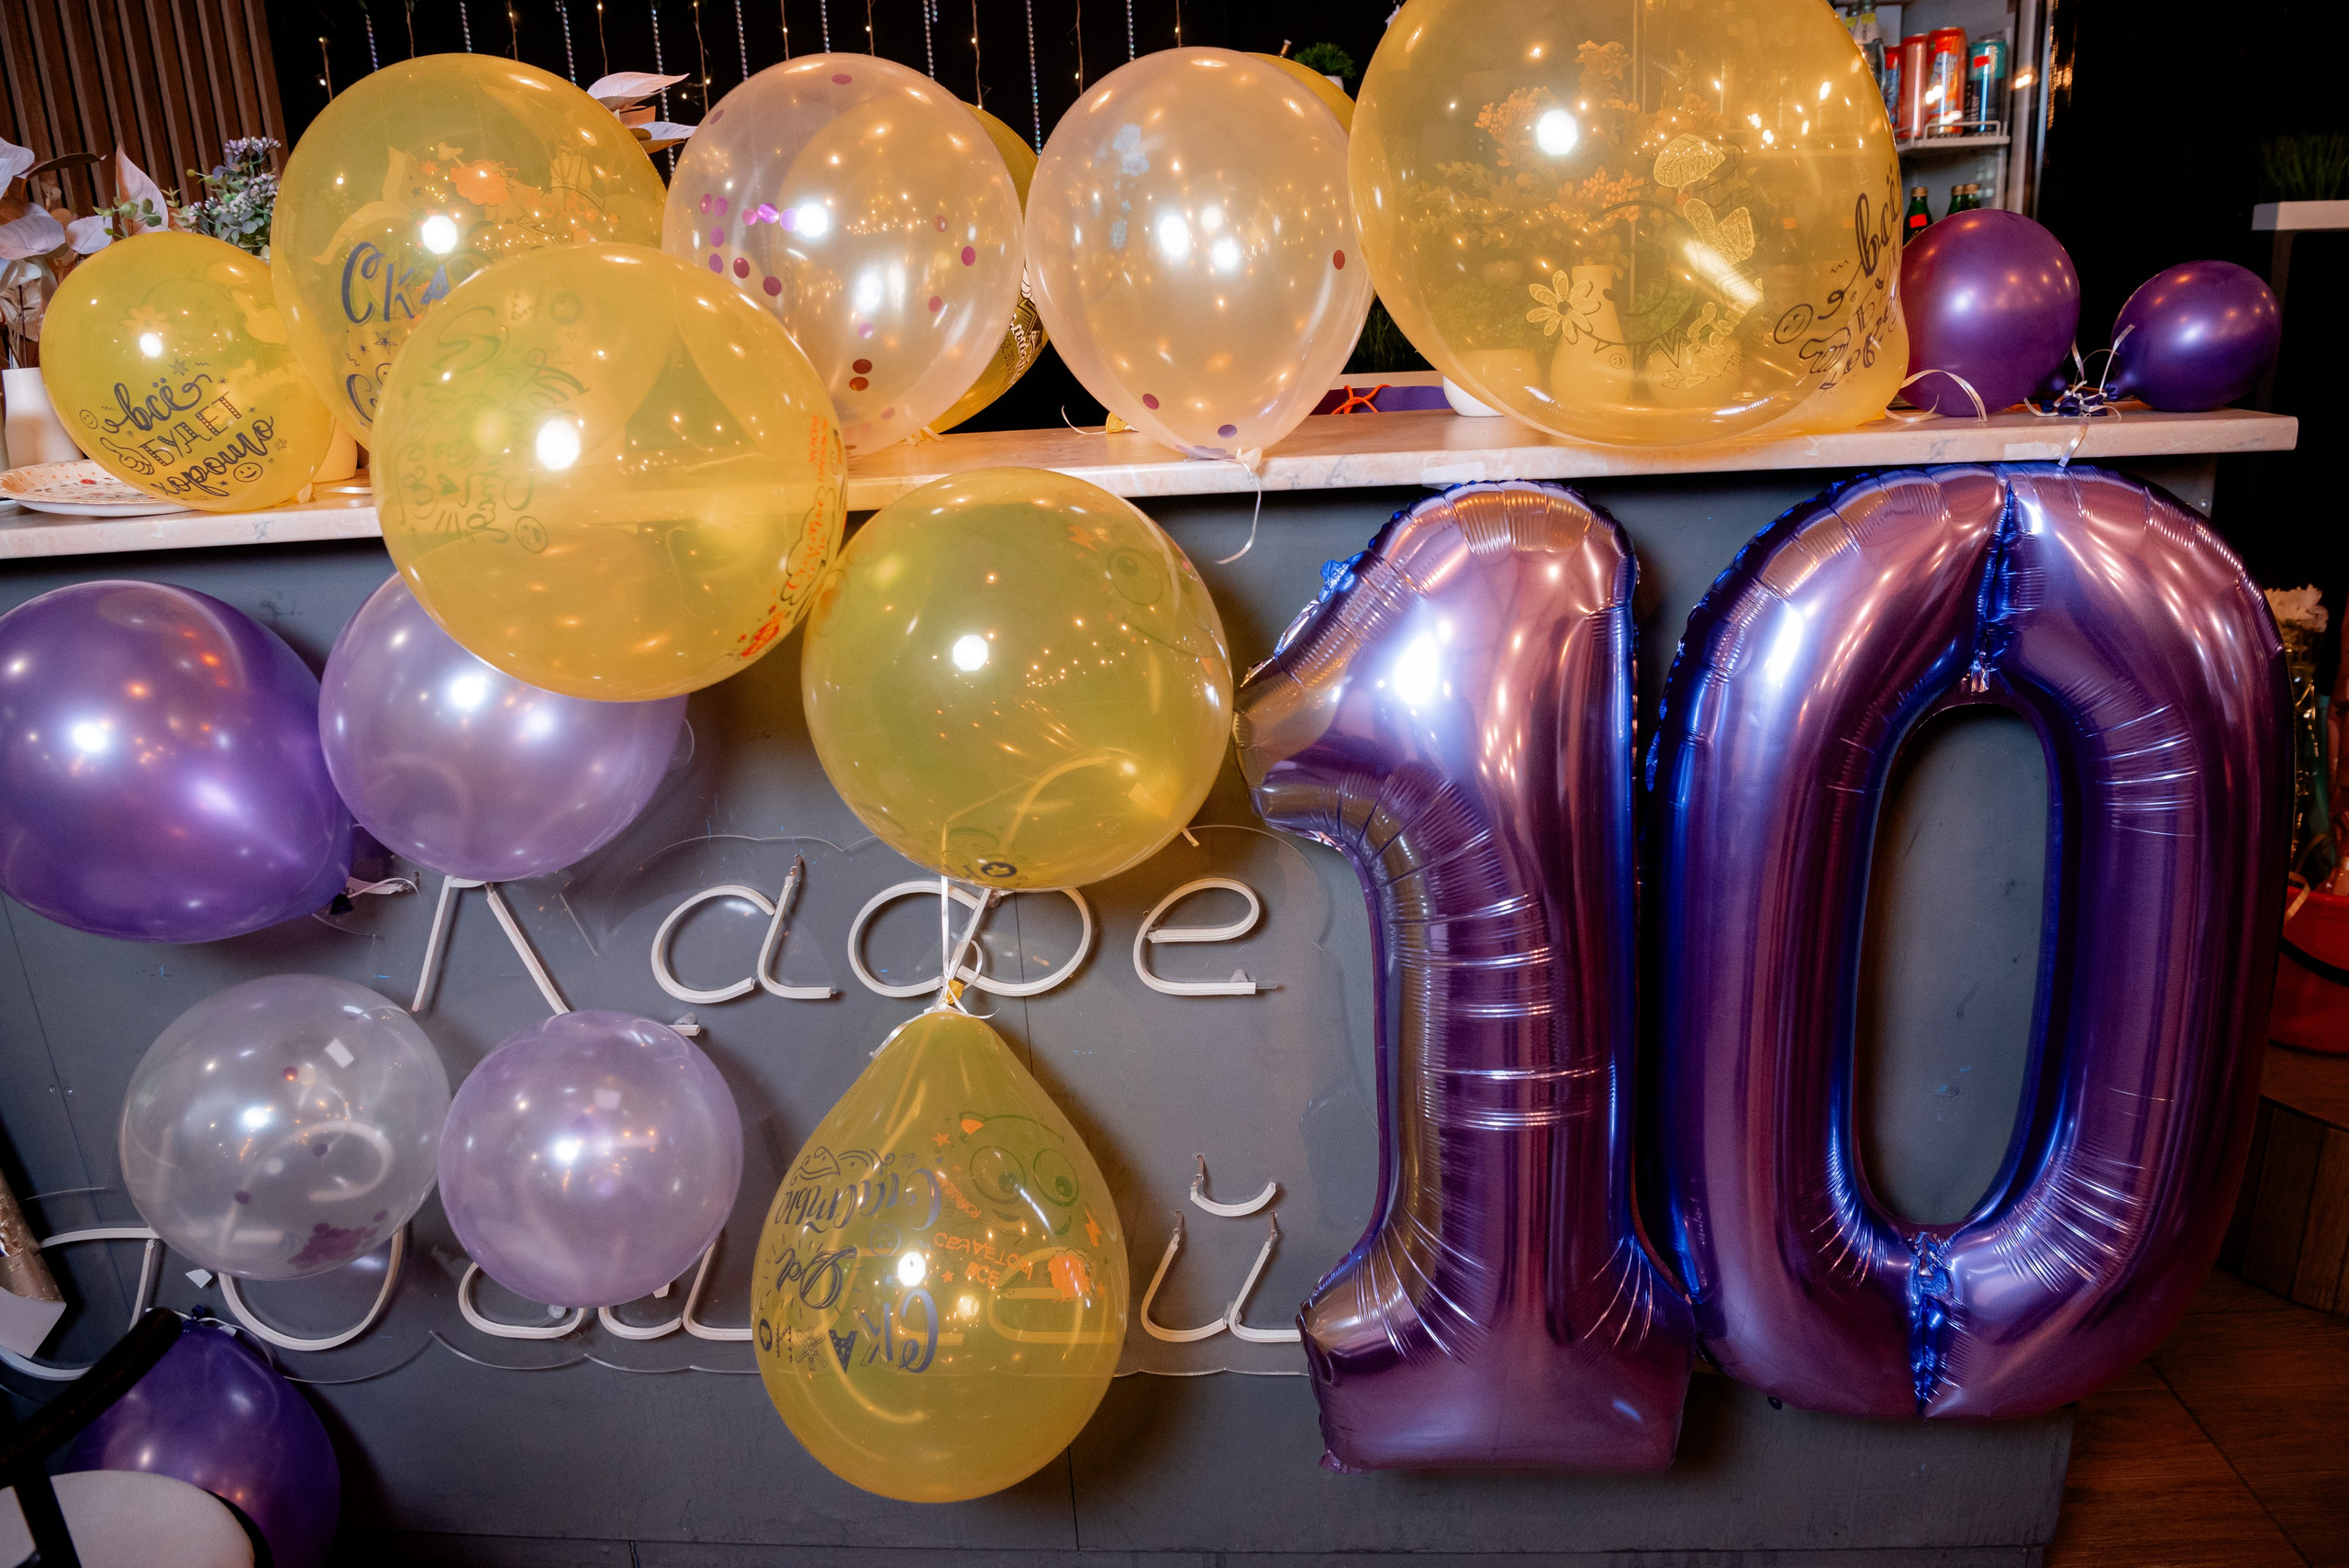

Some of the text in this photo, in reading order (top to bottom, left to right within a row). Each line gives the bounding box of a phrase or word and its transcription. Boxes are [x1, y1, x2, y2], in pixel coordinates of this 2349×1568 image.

[341, 241, 451, 328] СКА
[139, 391, 242, 466] БУДЕТ
[150, 417, 273, 497] хорошо
[1234, 466, 2291, 1472] 10
